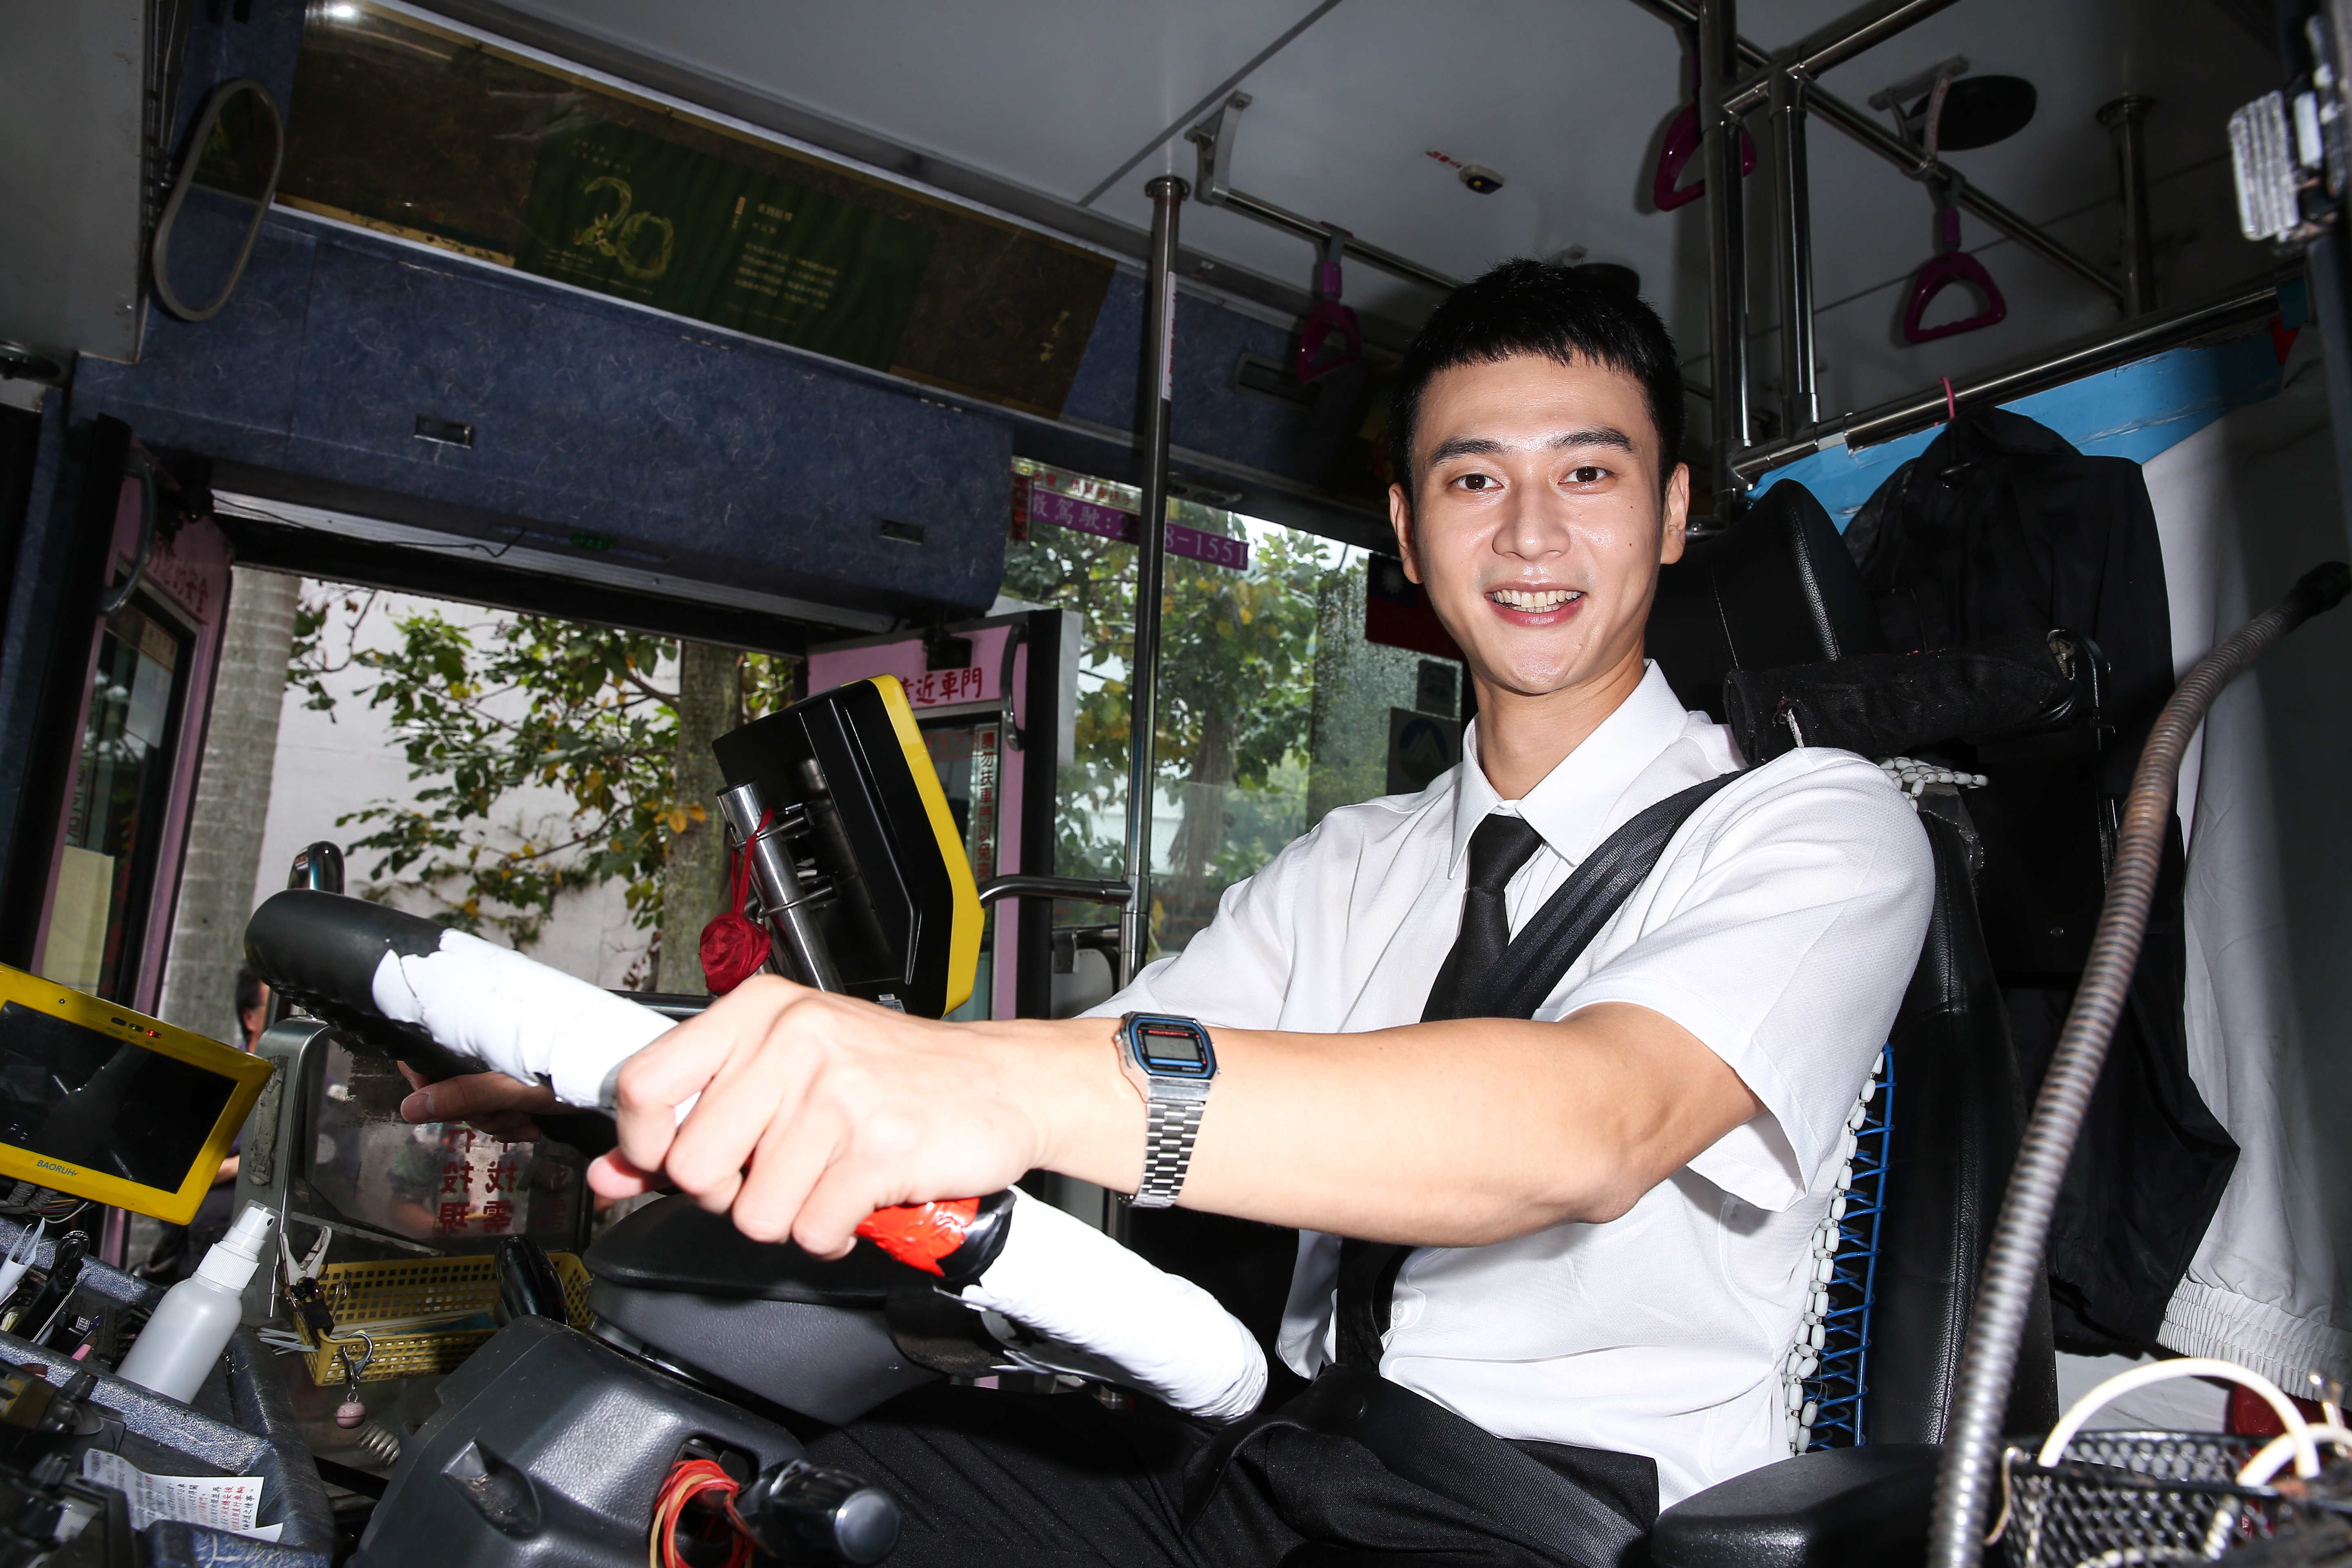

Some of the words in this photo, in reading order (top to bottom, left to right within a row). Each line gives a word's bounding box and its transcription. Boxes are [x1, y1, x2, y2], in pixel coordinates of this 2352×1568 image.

[977, 732, 995, 884] 請勿扶車門以免夾
[36, 1160, 76, 1176] BAORUH
